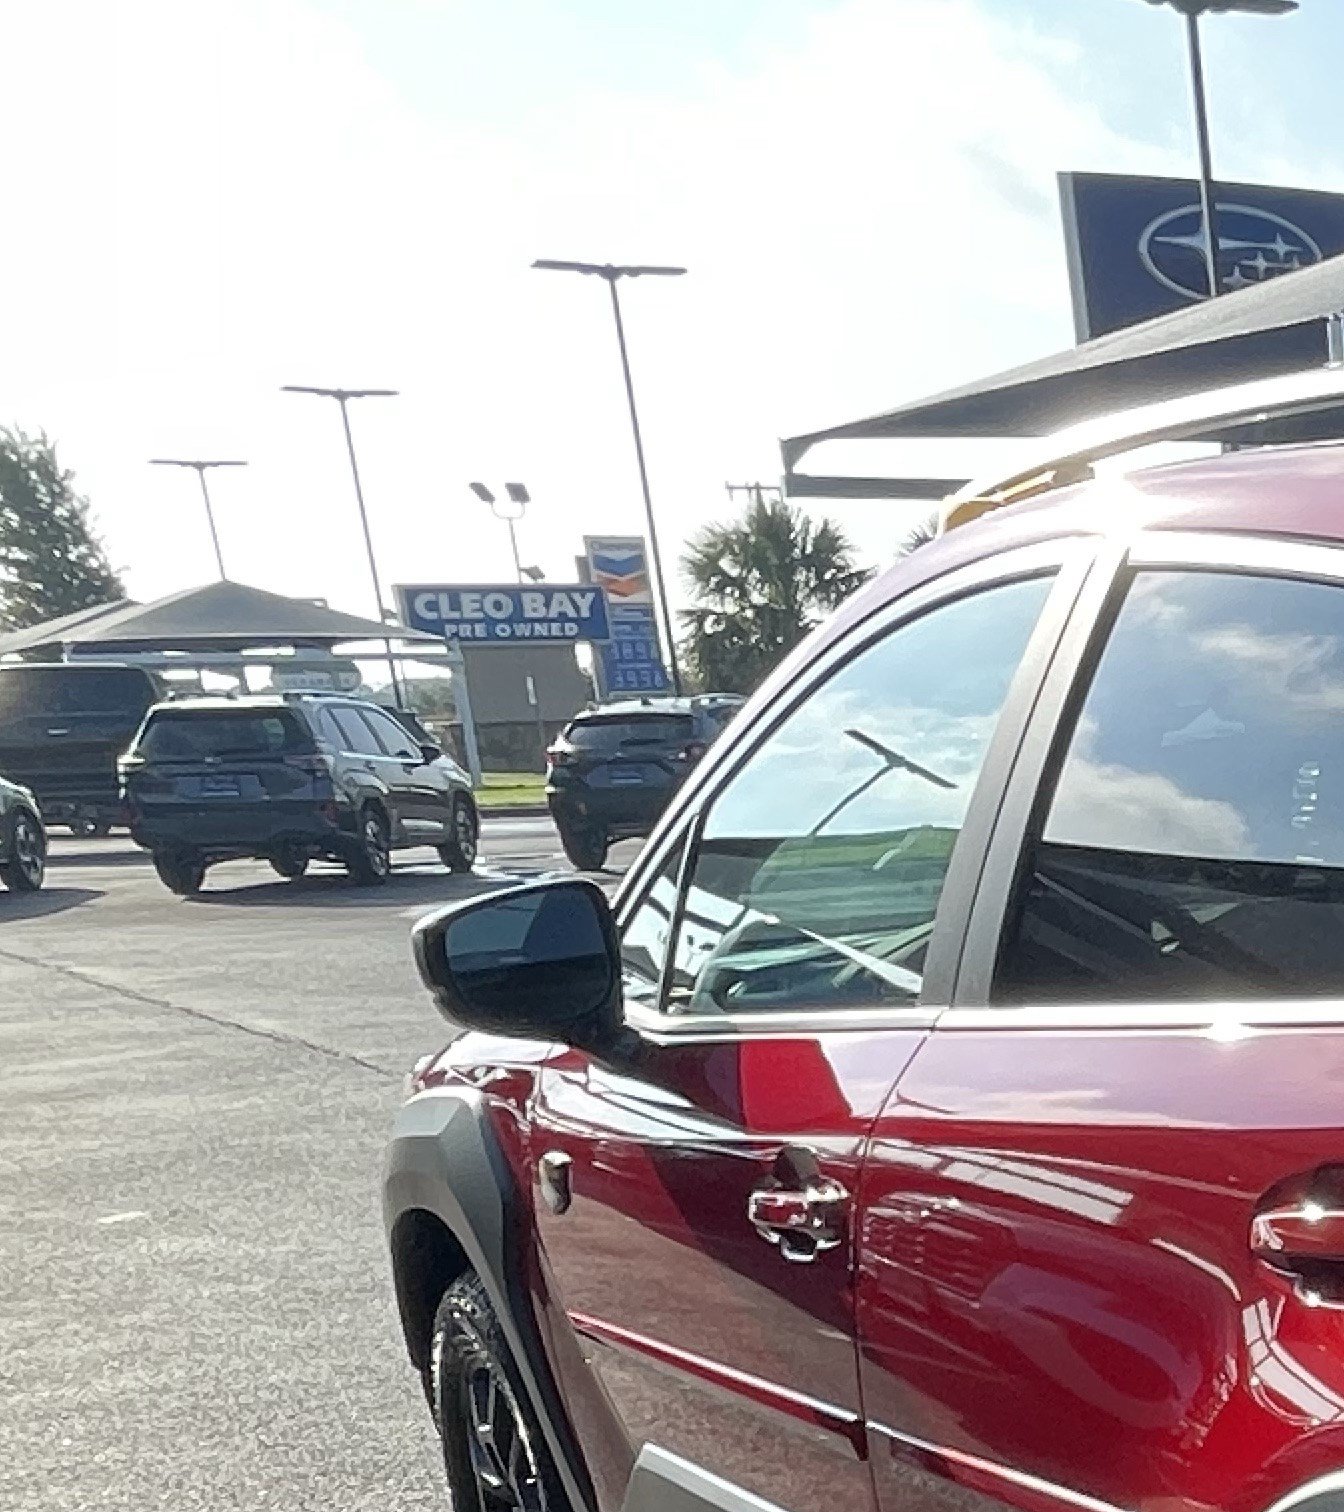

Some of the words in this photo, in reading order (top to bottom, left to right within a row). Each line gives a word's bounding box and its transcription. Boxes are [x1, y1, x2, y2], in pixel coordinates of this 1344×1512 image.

[413, 592, 514, 620] CLEO
[522, 592, 597, 619] BAY
[444, 623, 485, 638] PRE
[494, 623, 580, 638] OWNED
